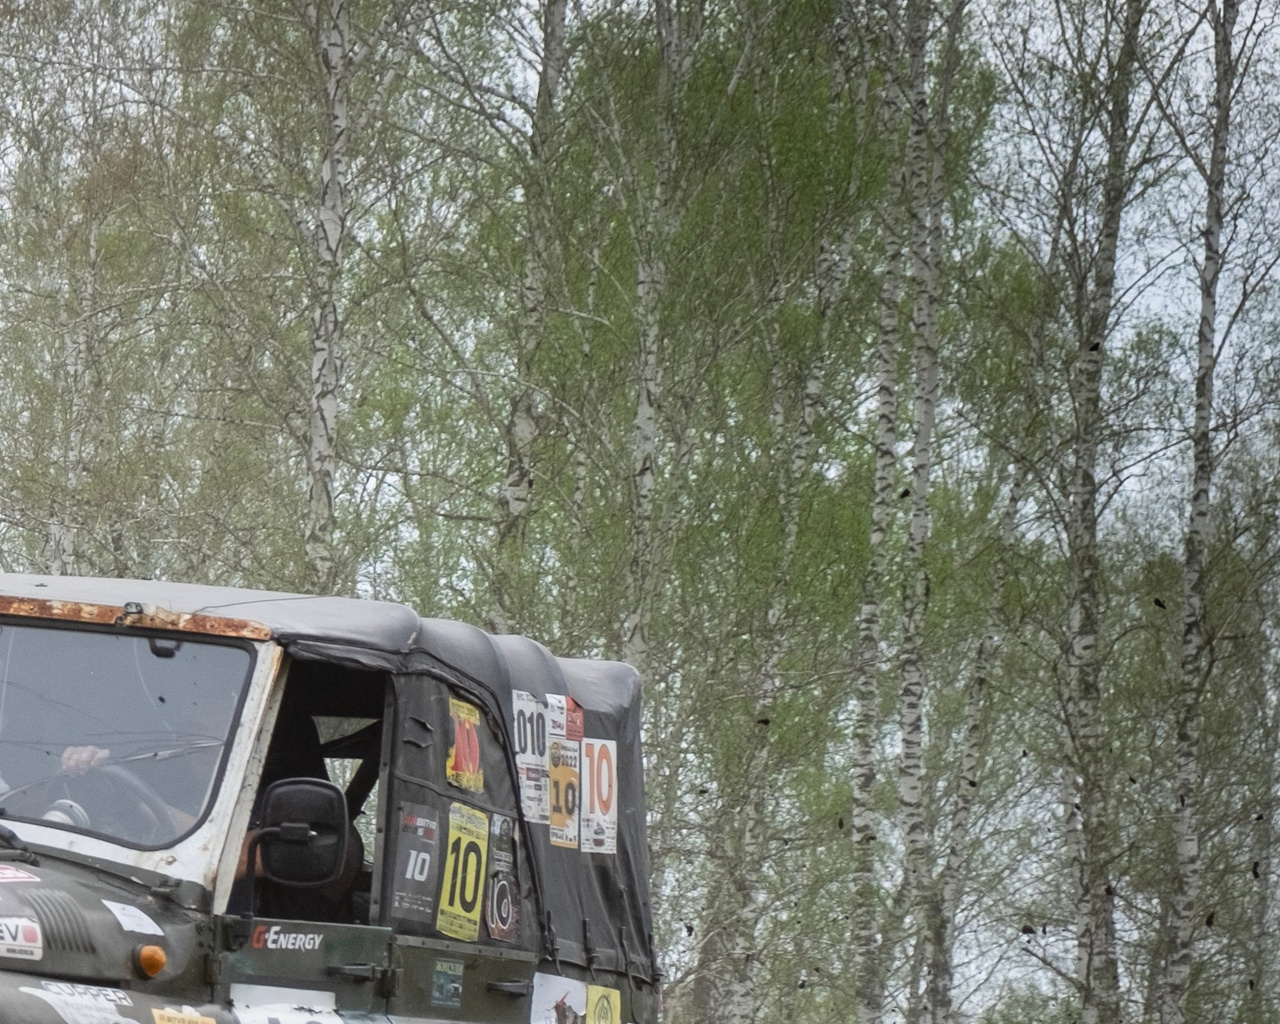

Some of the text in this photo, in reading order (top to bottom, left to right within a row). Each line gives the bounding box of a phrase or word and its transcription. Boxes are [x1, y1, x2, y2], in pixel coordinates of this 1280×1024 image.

[516, 709, 546, 757] 010
[552, 780, 576, 815] 10
[585, 742, 613, 816] 10
[405, 850, 431, 881] 10
[448, 836, 483, 913] 10
[43, 982, 132, 1005] CUPPER
